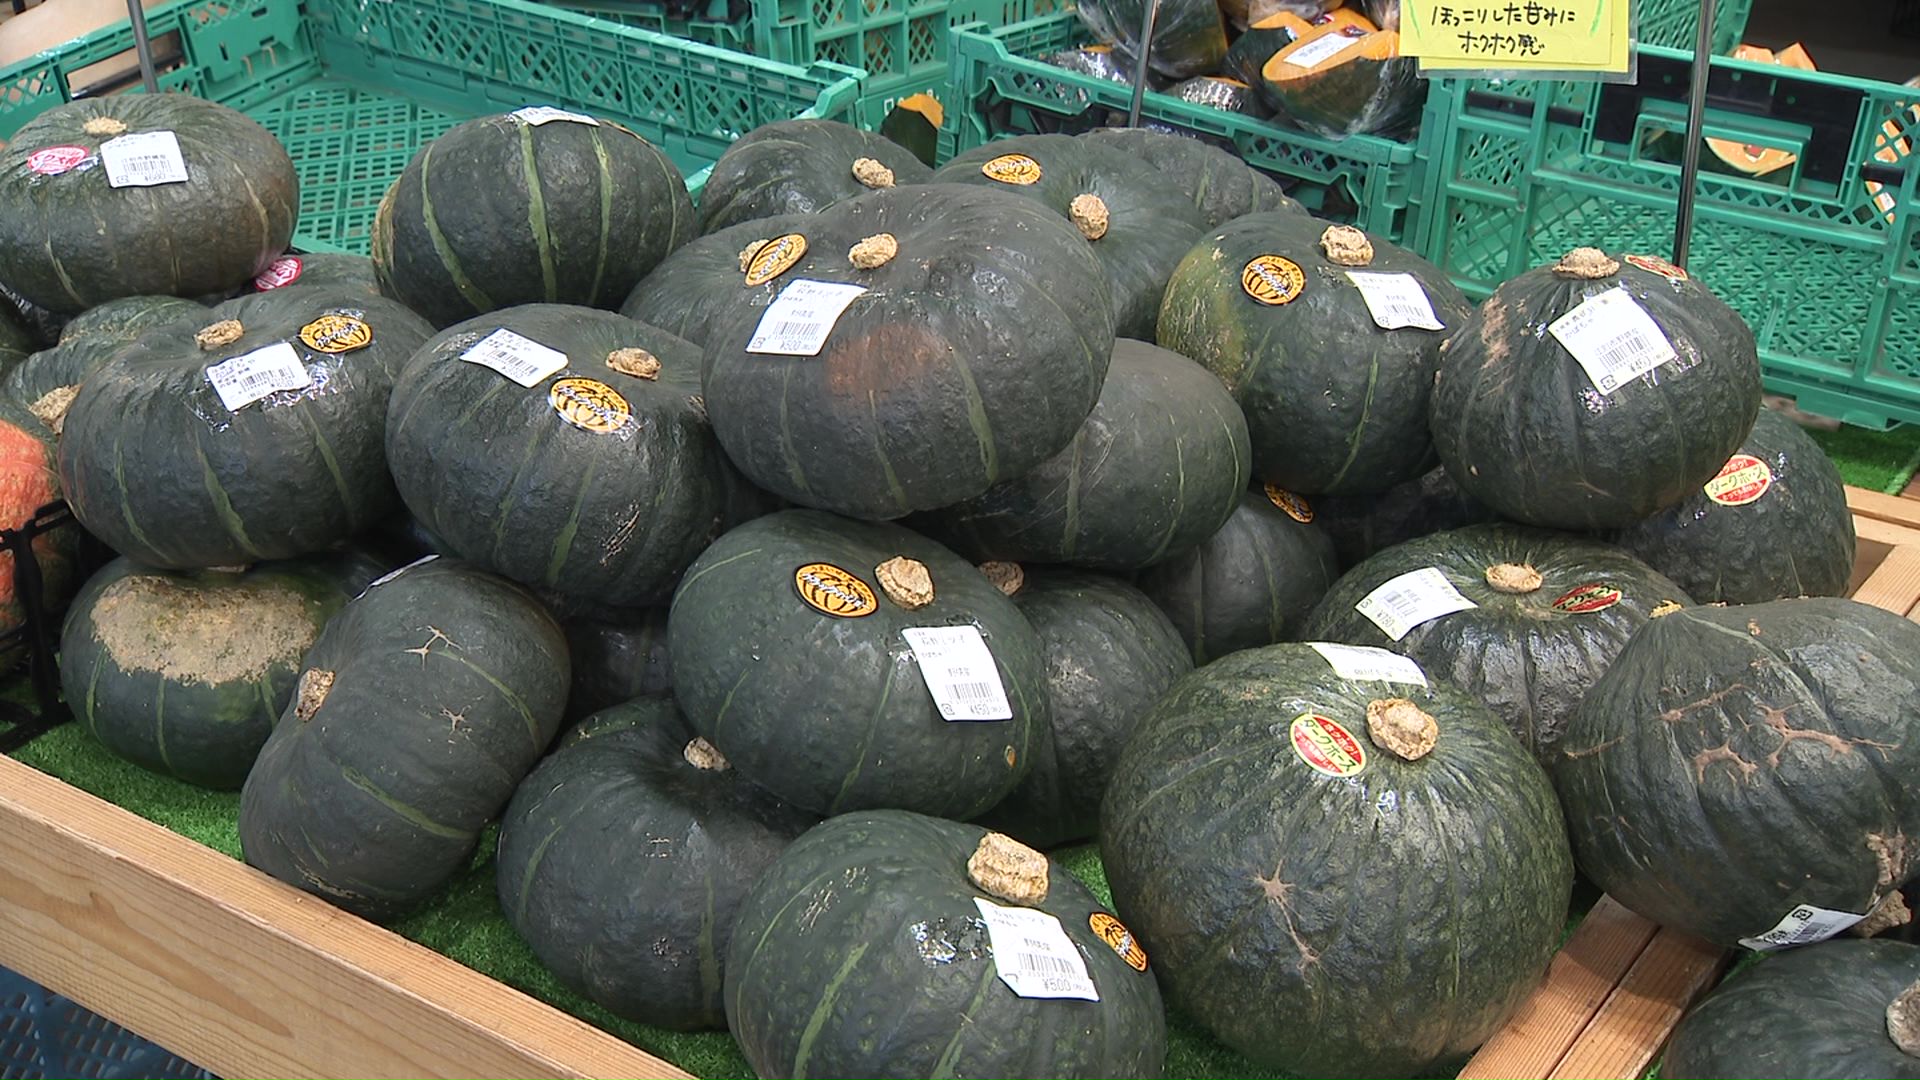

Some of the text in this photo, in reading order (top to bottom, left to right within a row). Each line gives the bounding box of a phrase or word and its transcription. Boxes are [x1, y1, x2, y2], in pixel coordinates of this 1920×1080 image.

[1431, 1, 1576, 26] ほっこりした甘みに
[1300, 718, 1357, 773] ダークホース
[1324, 723, 1359, 757] ホクホク!
[1043, 977, 1073, 993] ¥500
